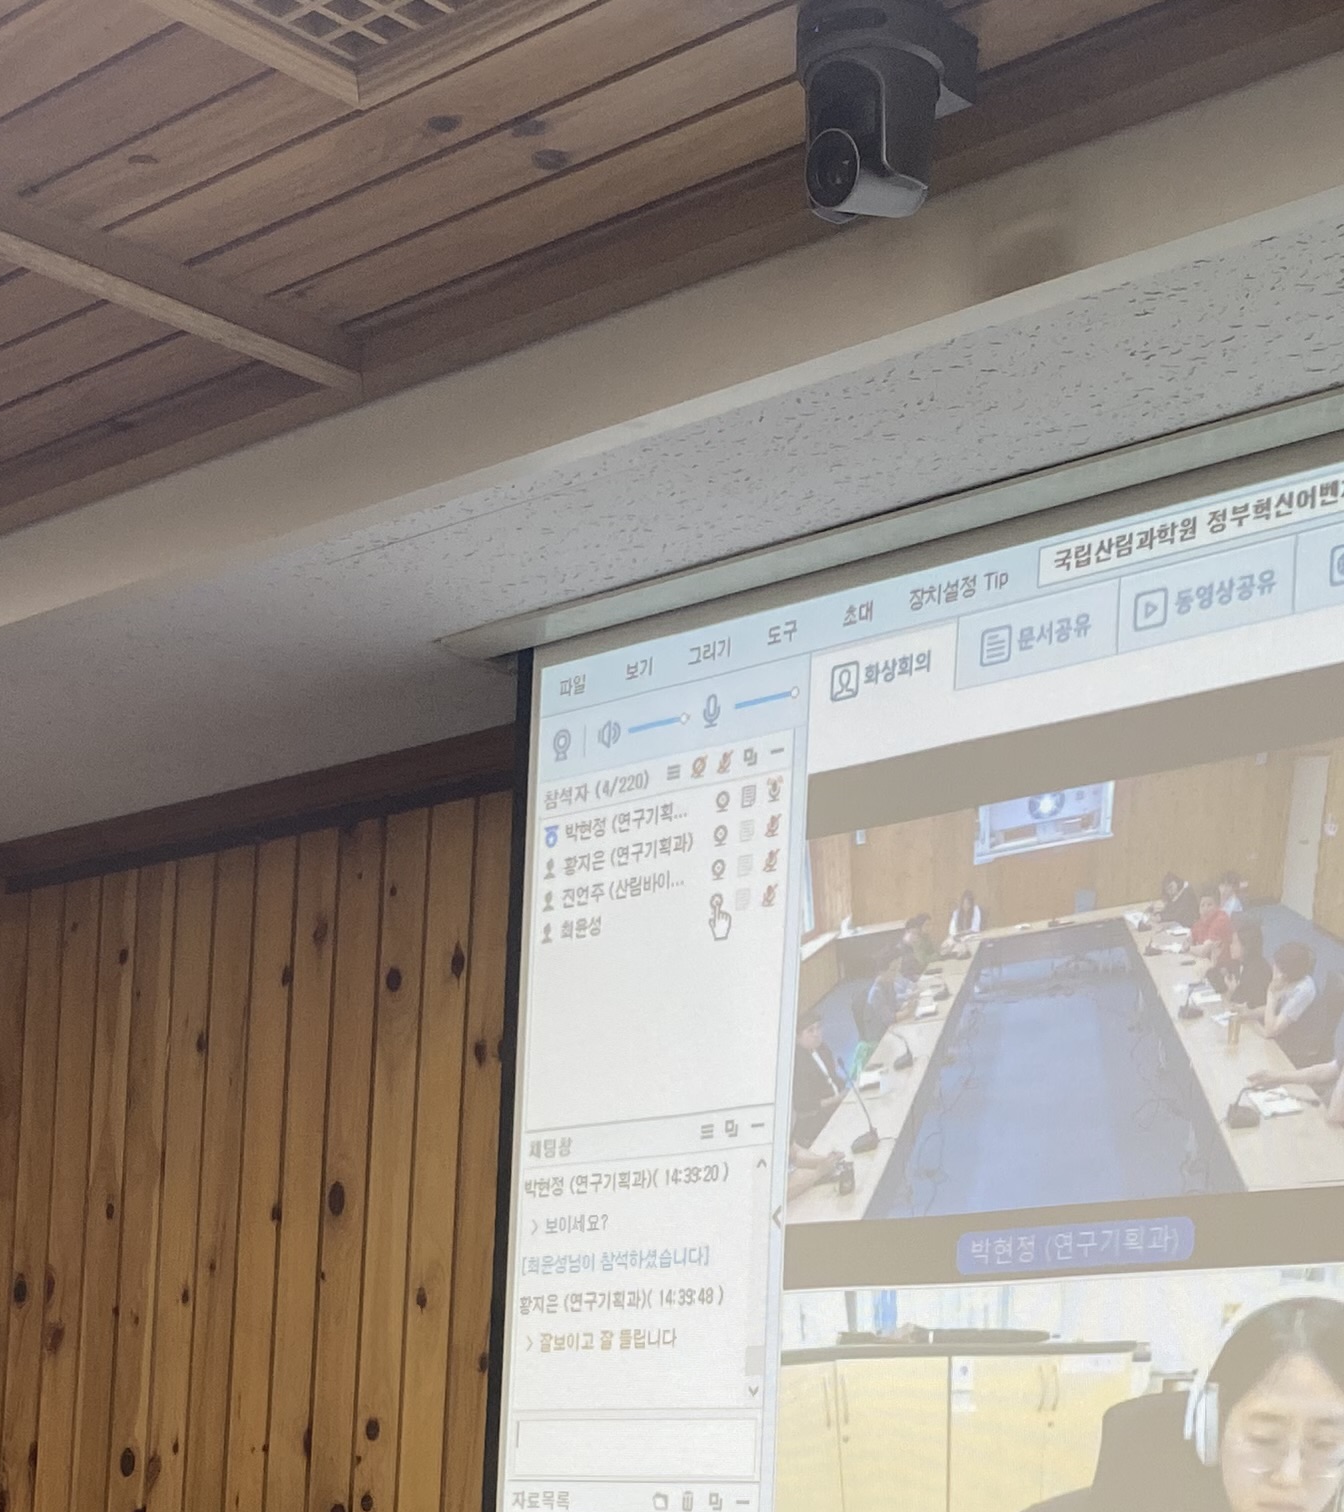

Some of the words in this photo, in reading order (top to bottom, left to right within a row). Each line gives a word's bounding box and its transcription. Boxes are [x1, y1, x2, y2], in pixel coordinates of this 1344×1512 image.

[1054, 517, 1197, 572] 국립산림과학원
[909, 575, 976, 611] 장치설정
[984, 571, 1009, 592] Tip
[1175, 569, 1277, 614] 동영상공유
[843, 600, 874, 627] 초대
[767, 620, 798, 647] 도구
[1017, 613, 1092, 652] 문서공유
[689, 637, 732, 666] 그리기
[626, 656, 654, 681] 보기
[864, 650, 931, 685] 화상회의
[559, 675, 586, 697] 파일
[544, 784, 588, 810] 참석자
[595, 770, 650, 798] (4/220)
[565, 818, 607, 841] 박현정
[611, 832, 694, 867] (연구기획과)
[561, 883, 604, 909] 진언주
[524, 1176, 564, 1198] 박현정
[545, 1214, 609, 1235] 보이세요?
[970, 1236, 1037, 1265] 박현정
[1044, 1225, 1181, 1261] (연구기획과)
[519, 1294, 559, 1316] 황지은
[618, 1327, 677, 1351] 들립니다
[512, 1490, 570, 1510] 자료목록
